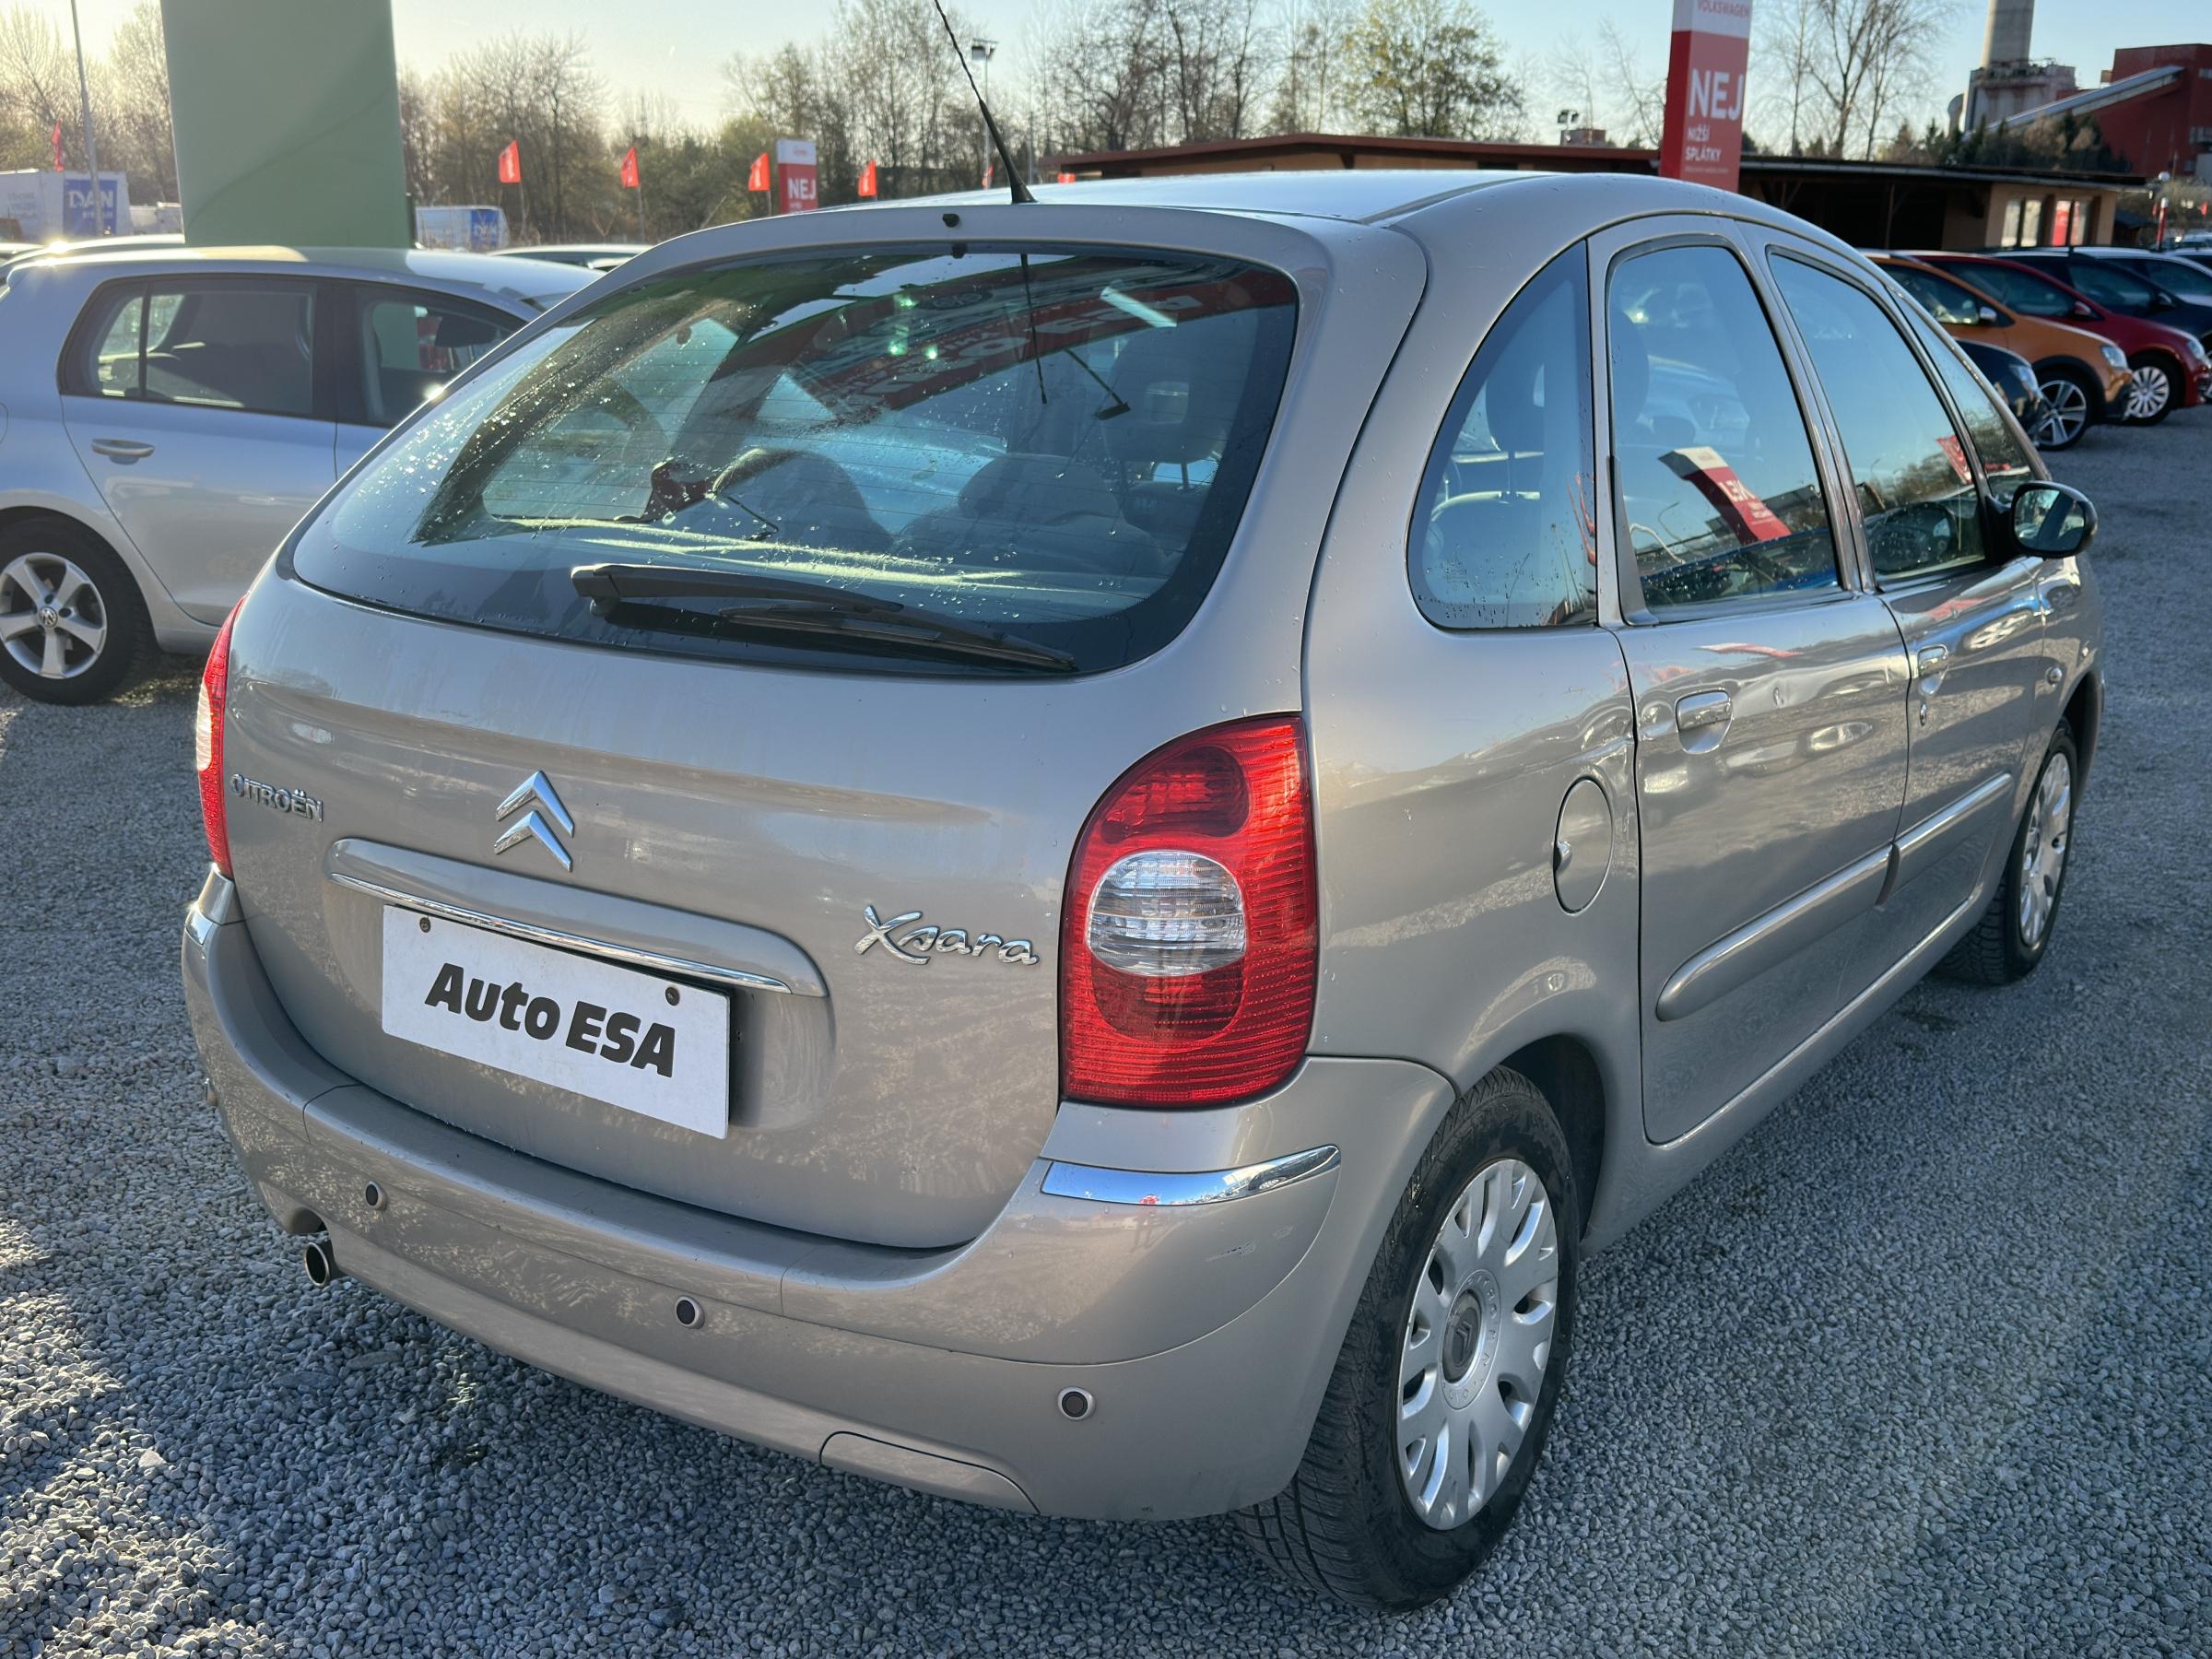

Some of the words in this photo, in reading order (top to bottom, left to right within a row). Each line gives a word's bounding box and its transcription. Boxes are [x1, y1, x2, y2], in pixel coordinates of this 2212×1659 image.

[1688, 69, 1744, 121] NEJ
[787, 178, 817, 199] NEJ
[229, 773, 324, 822] CITROËN
[854, 905, 1040, 965] Xsara
[424, 962, 560, 1041] Auto
[565, 1000, 676, 1078] ESA
